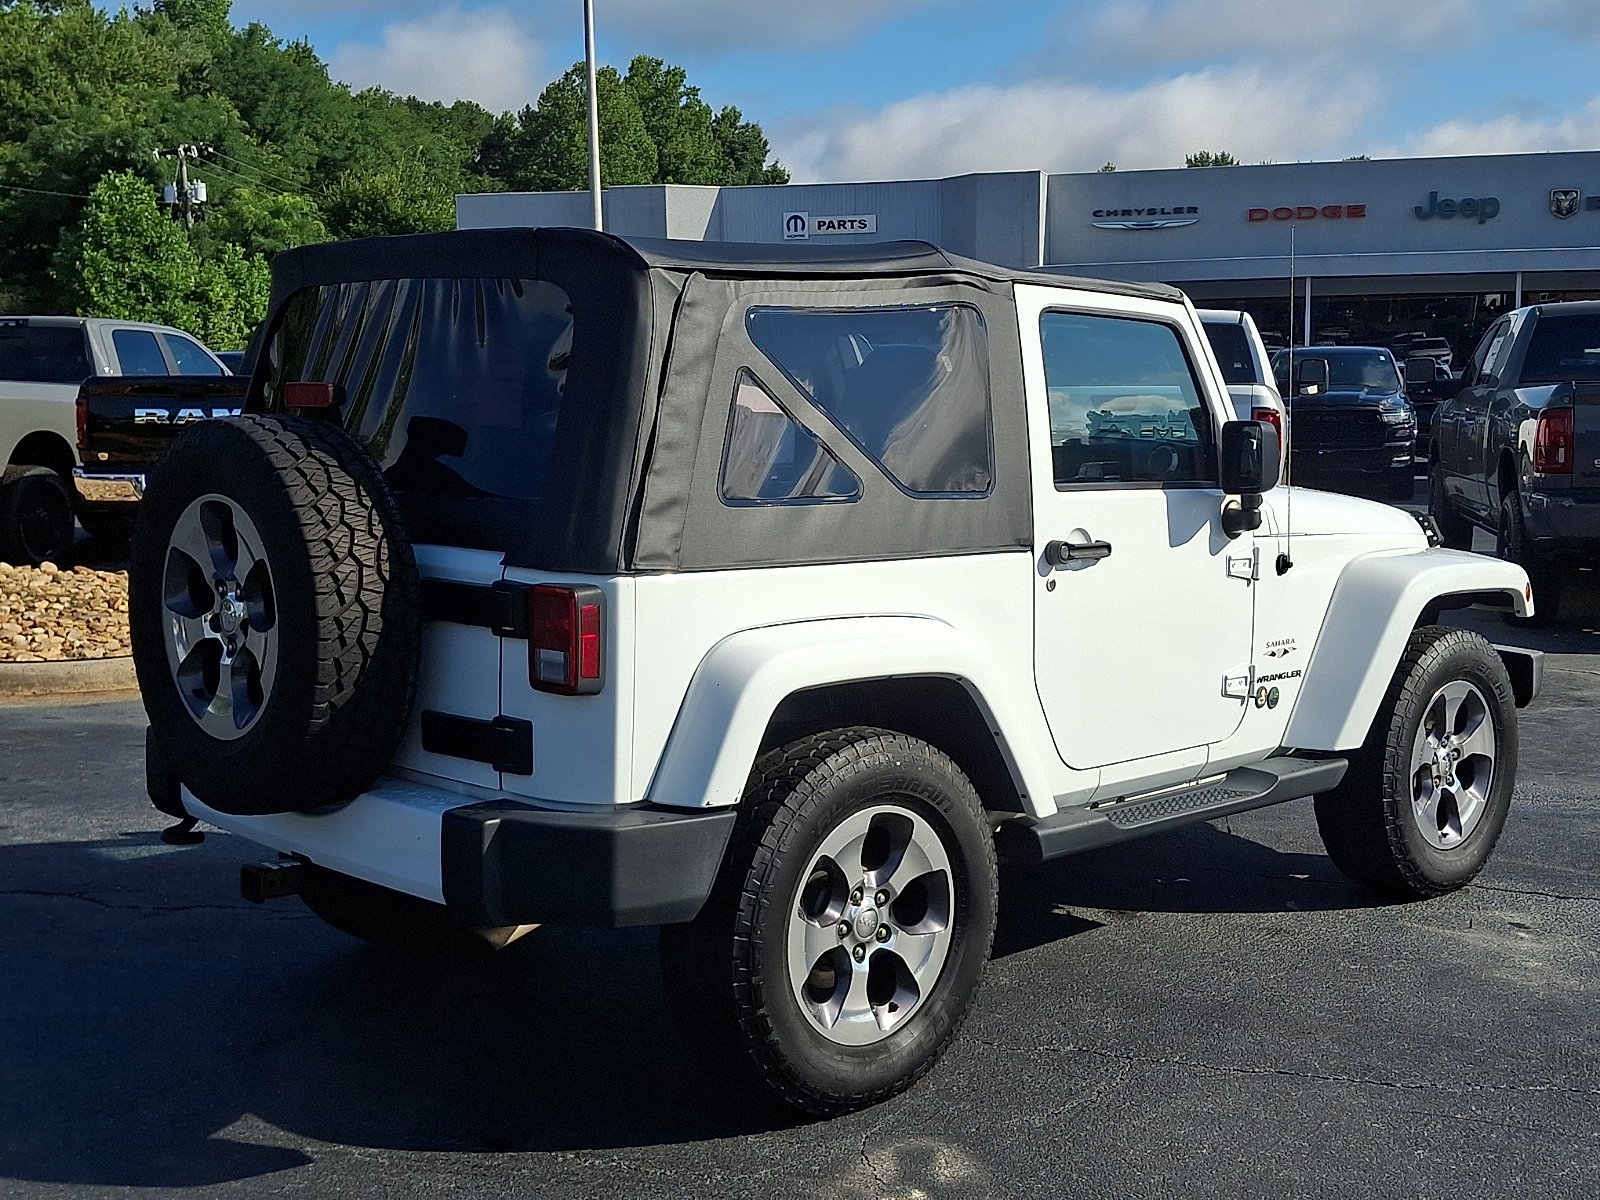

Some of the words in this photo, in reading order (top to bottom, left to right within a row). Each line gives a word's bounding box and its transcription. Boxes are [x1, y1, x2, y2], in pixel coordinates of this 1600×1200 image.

[1092, 206, 1199, 218] CHRYSLER
[1248, 204, 1367, 222] DODGE
[1414, 191, 1500, 224] Jeep
[817, 219, 868, 231] PARTS
[1266, 638, 1295, 648] SAHARA
[1257, 670, 1301, 684] WRANGLER
